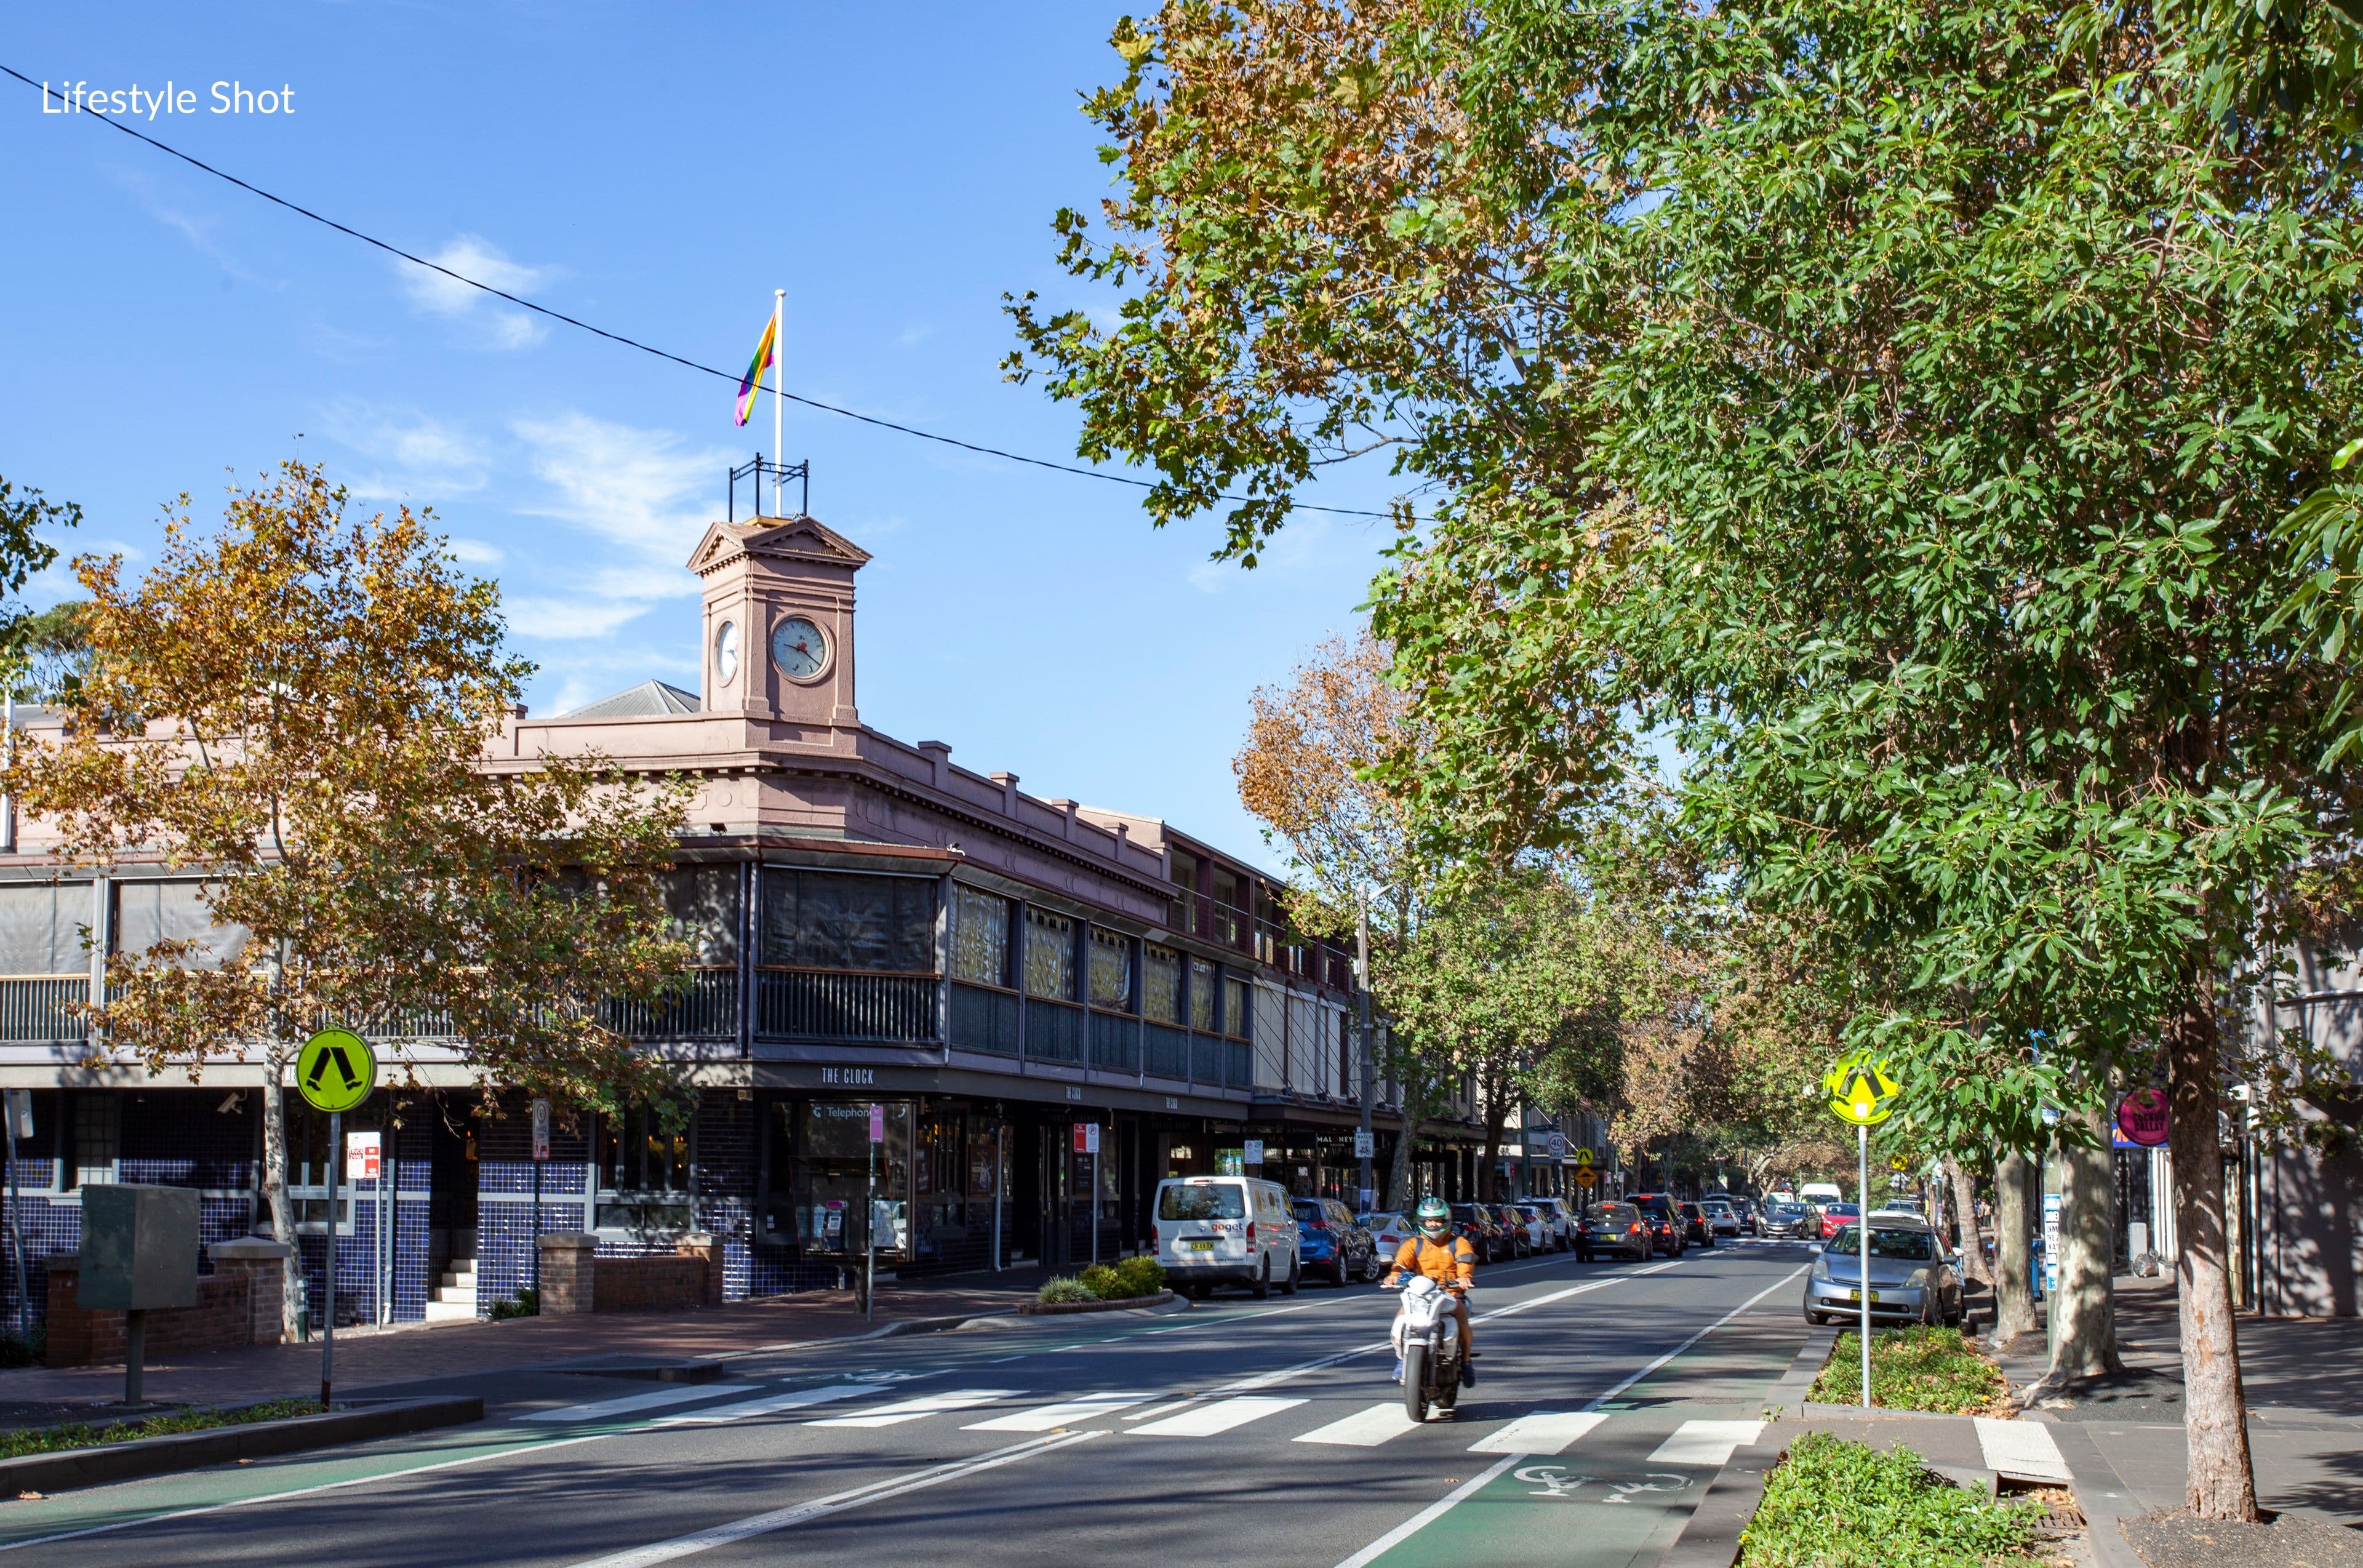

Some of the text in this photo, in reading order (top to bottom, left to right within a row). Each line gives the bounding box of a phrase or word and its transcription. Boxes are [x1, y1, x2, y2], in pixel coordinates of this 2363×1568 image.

[773, 623, 822, 647] CLOCK HOTEL
[822, 1068, 873, 1084] THE CLOCK
[2135, 1122, 2164, 1132] CALLAY
[1211, 1223, 1243, 1233] goget
